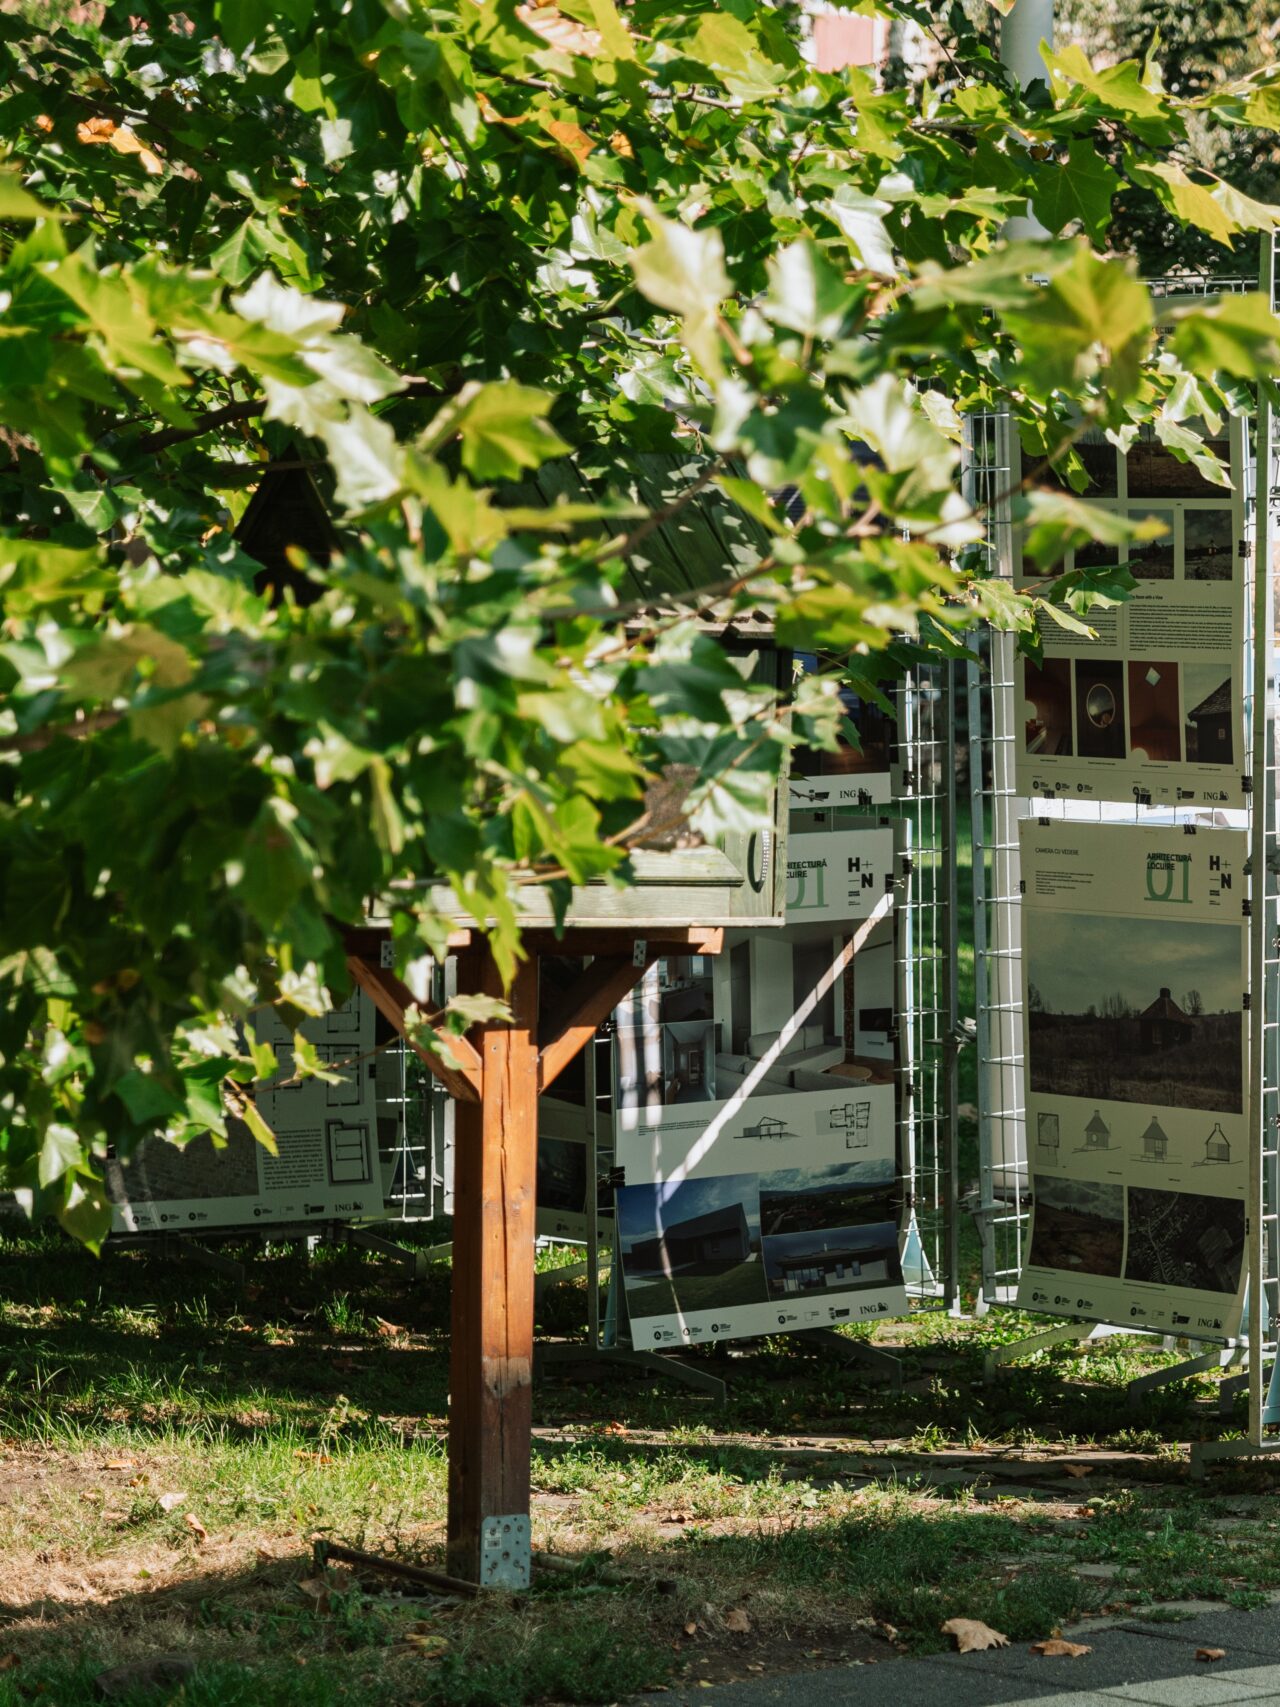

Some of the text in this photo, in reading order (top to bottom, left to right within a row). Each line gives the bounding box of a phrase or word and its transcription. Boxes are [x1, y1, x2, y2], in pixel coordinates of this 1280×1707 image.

[840, 790, 857, 799] ING
[1203, 791, 1219, 801] ING
[335, 1204, 354, 1212] ING
[860, 1304, 877, 1314] ING
[1197, 1318, 1212, 1328] ING
